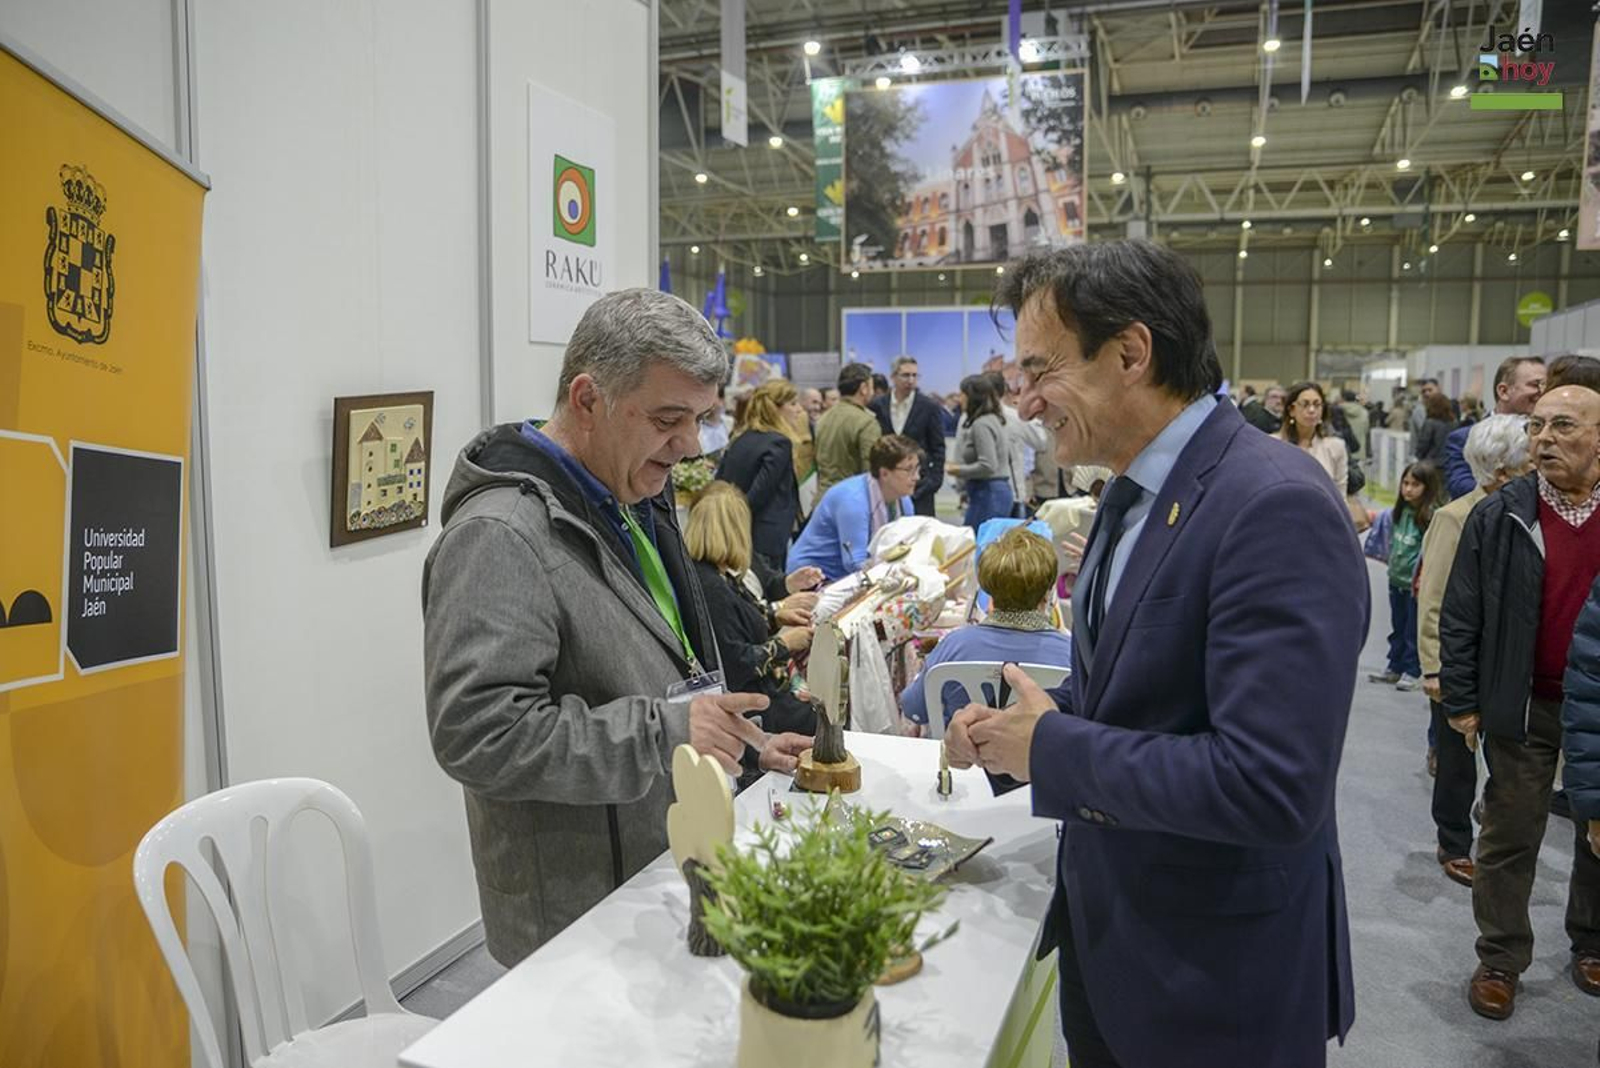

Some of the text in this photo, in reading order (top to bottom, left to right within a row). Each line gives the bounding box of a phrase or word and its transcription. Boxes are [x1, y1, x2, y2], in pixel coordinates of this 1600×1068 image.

[546, 249, 602, 287] RAKU
[84, 527, 145, 548] Universidad
[83, 550, 124, 576] Popular
[83, 571, 134, 597] Municipal
[81, 596, 106, 618] Jaén
